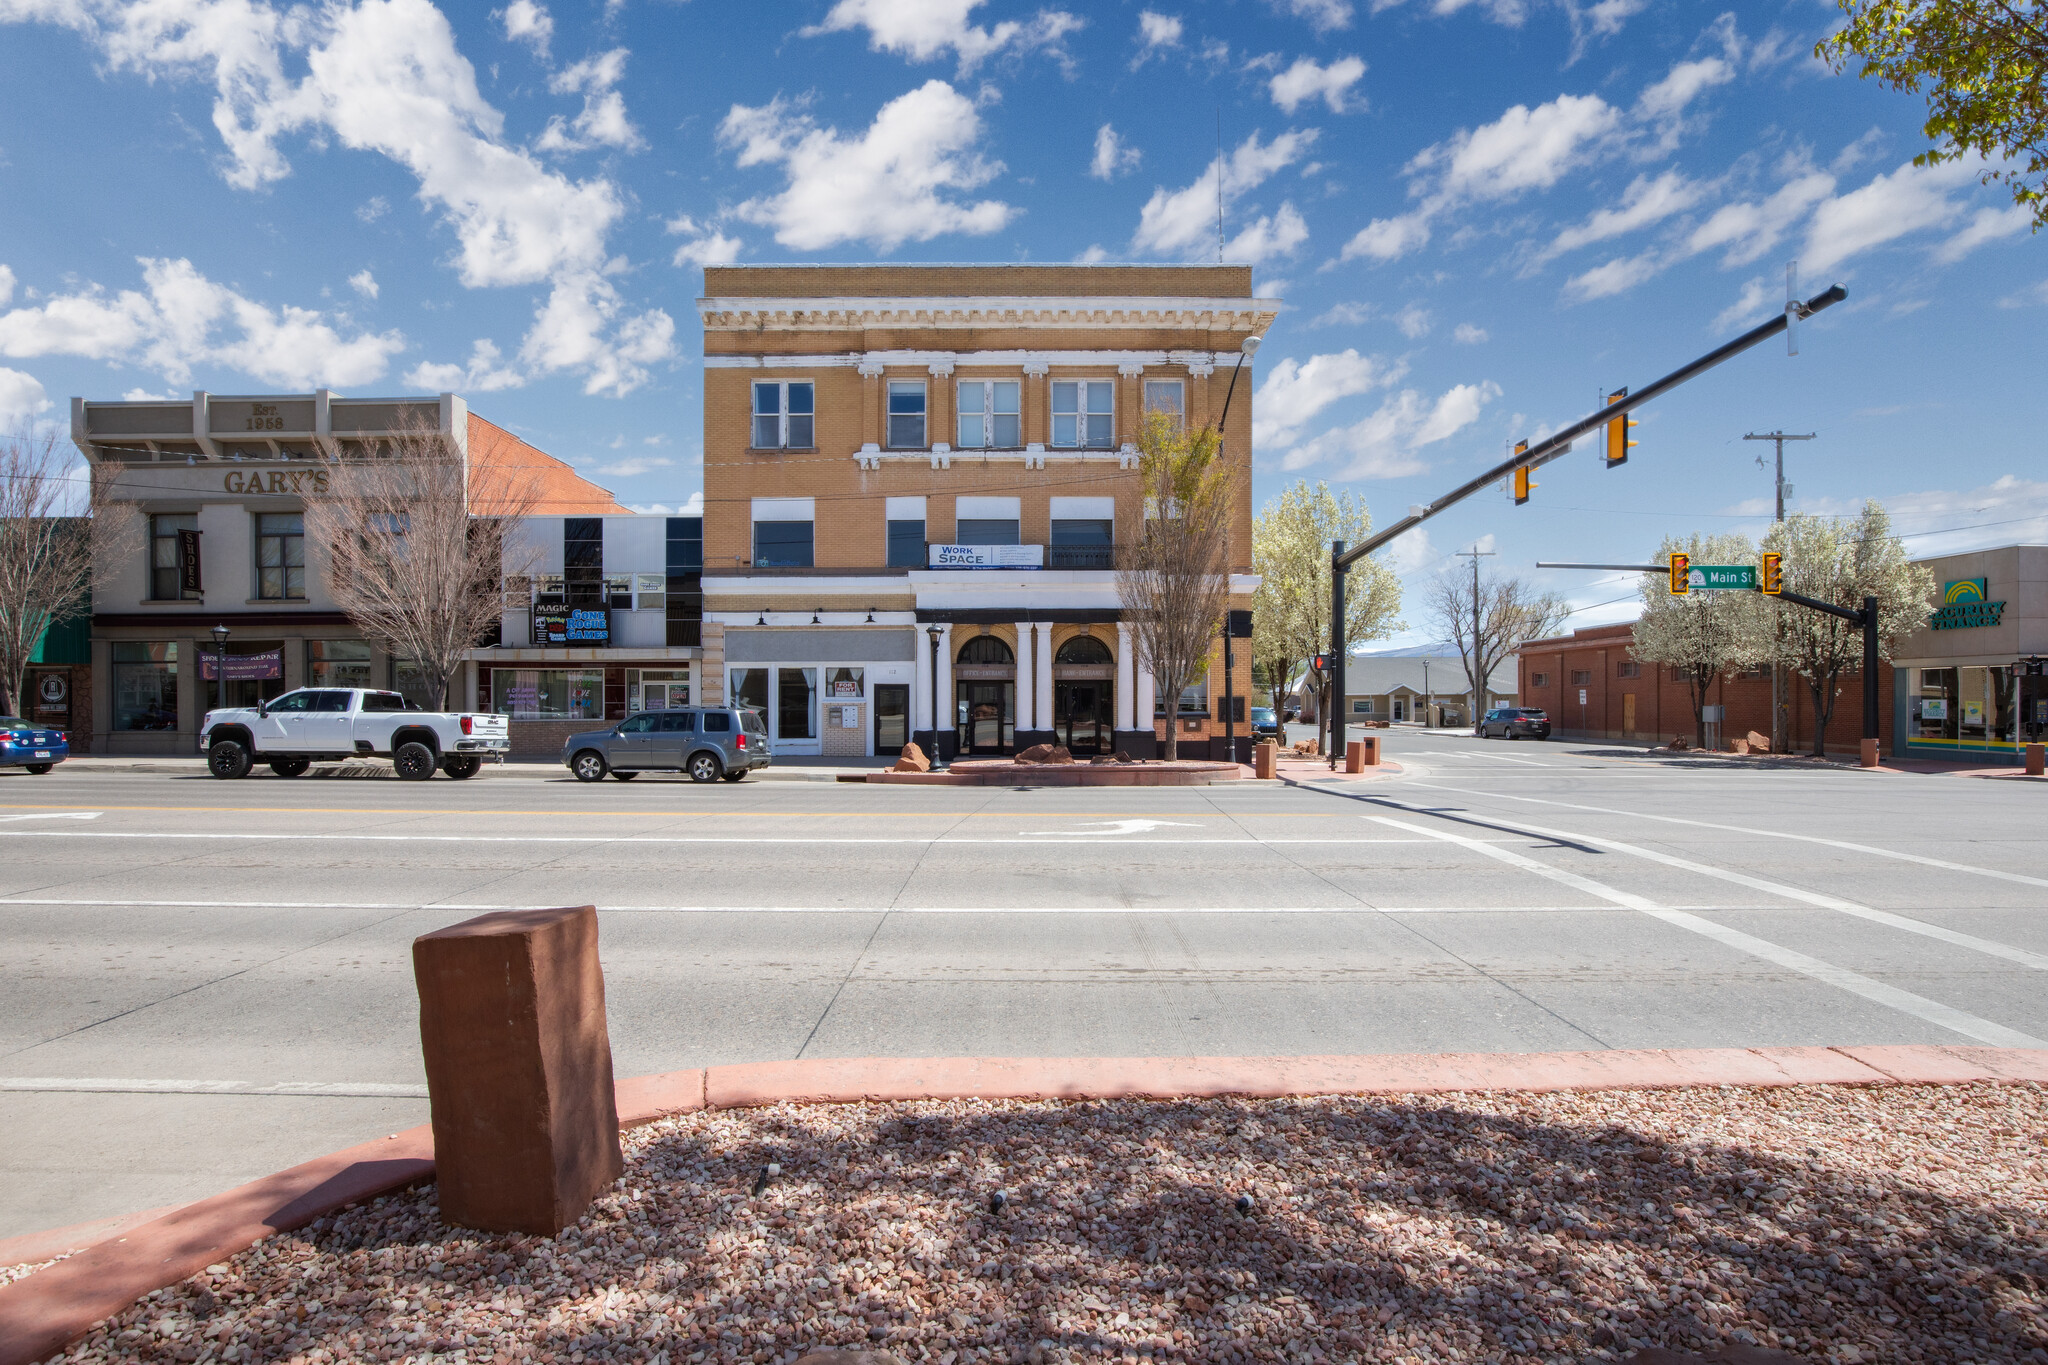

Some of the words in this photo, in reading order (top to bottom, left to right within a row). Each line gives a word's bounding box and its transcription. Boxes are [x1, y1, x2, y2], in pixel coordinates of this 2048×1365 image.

[224, 469, 330, 494] GARY'S
[941, 546, 974, 554] WORK
[185, 533, 196, 587] SHOES
[938, 554, 984, 564] SPACE
[1710, 571, 1737, 583] Main
[1741, 571, 1753, 583] St
[536, 604, 569, 612] MAGIC
[572, 609, 606, 620] GONE
[566, 618, 607, 629] ROGUE
[1931, 614, 2000, 631] FINANCE
[566, 628, 609, 640] GAMES
